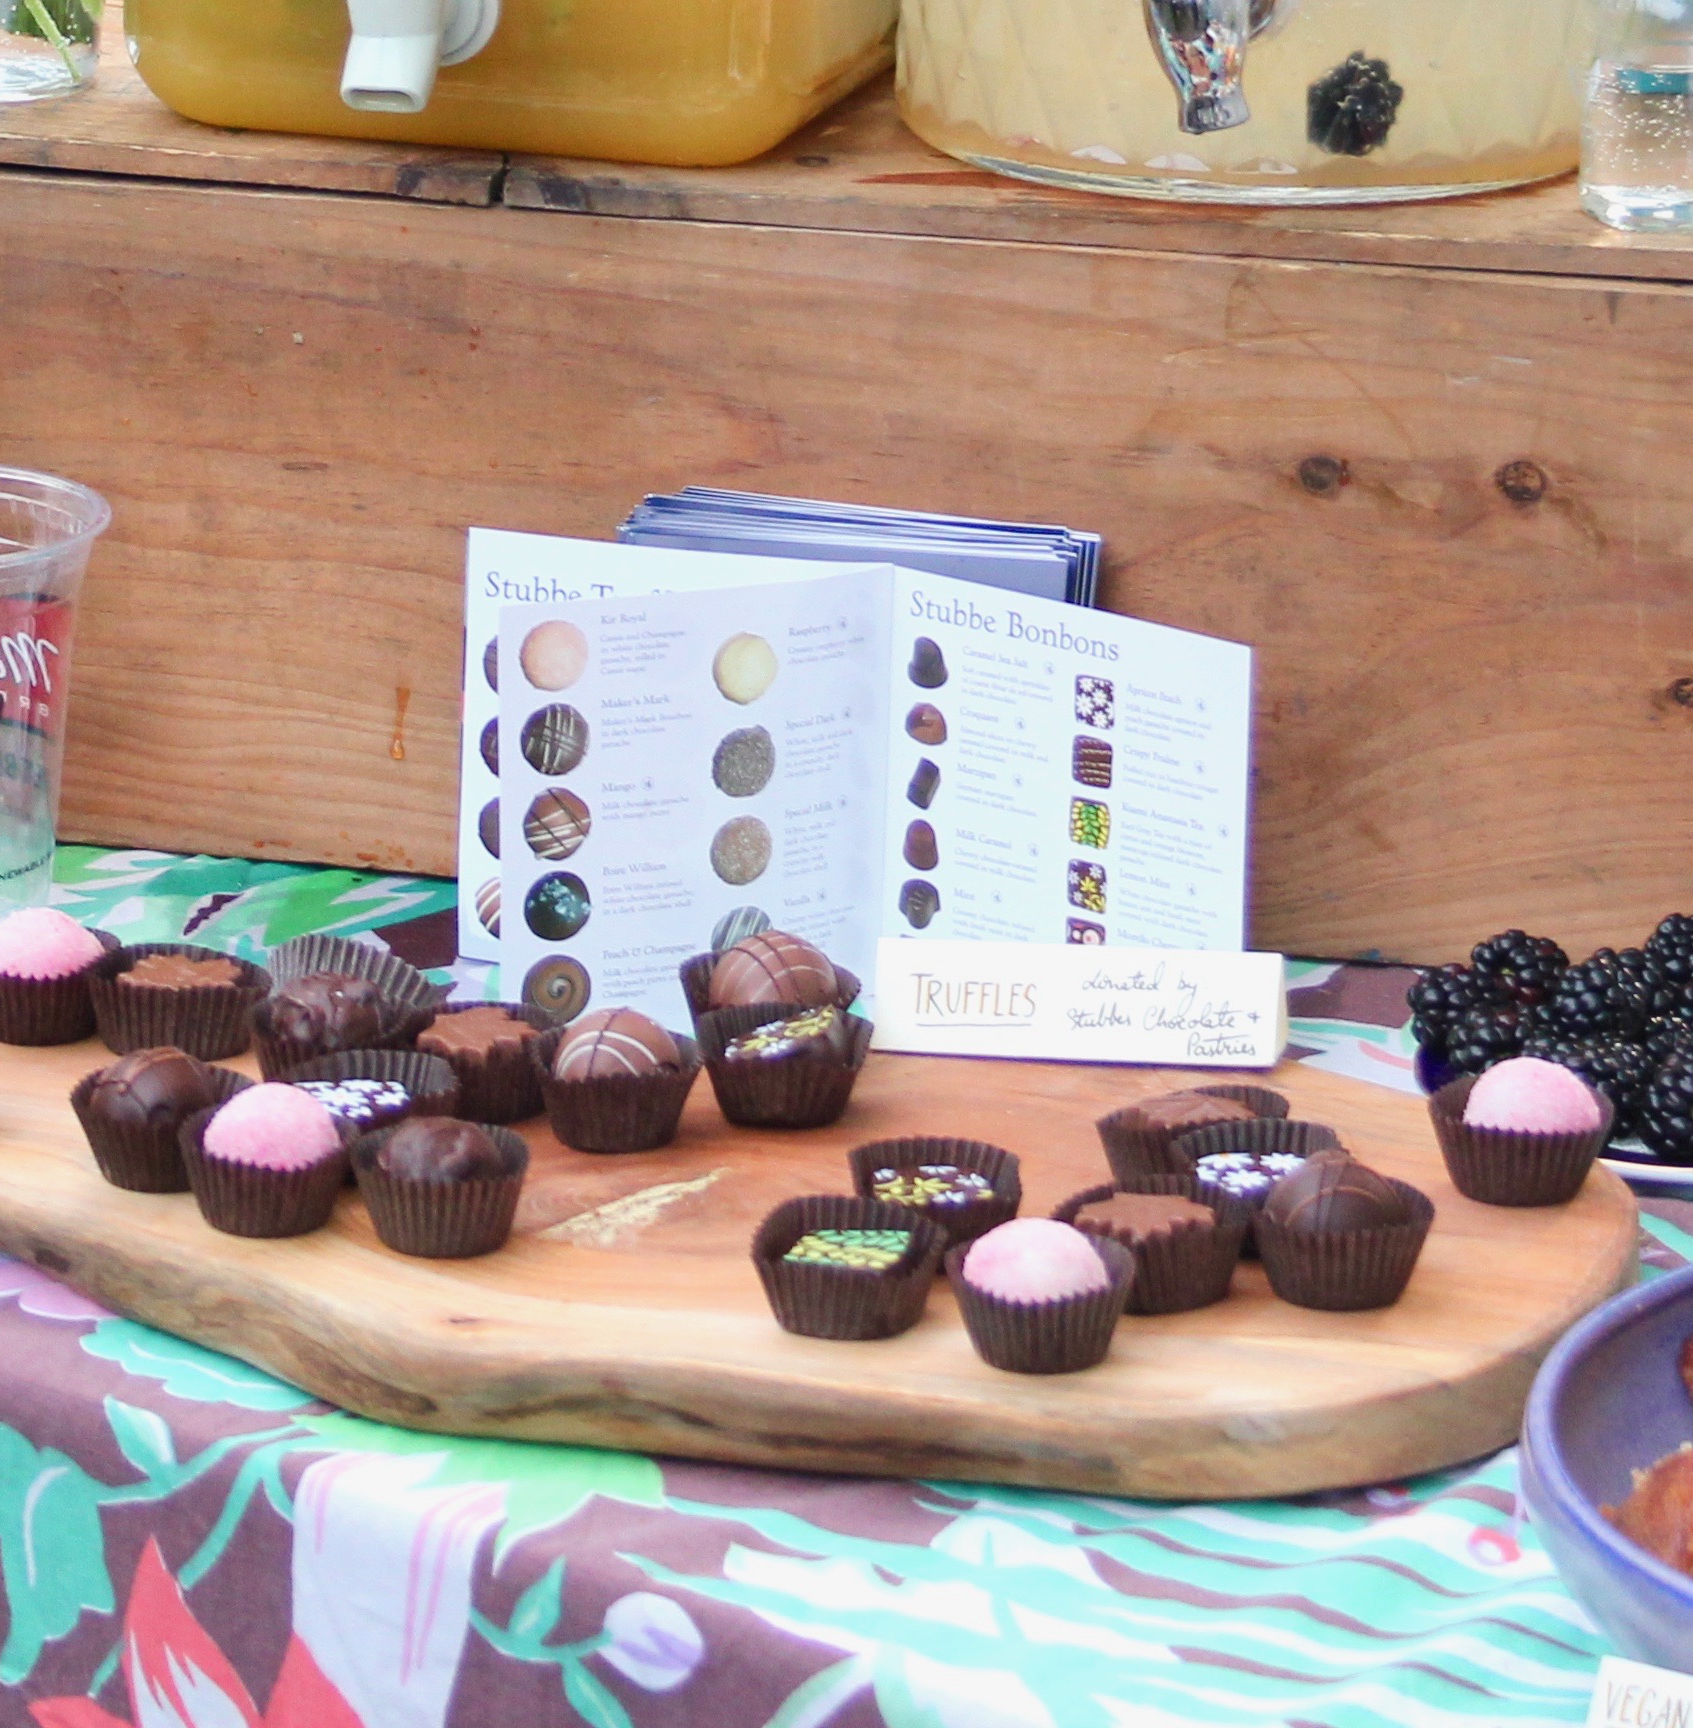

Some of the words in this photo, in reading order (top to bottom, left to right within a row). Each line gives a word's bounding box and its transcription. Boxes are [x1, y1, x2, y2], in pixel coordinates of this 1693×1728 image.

[909, 590, 998, 634] Stubbe
[1006, 610, 1121, 663] Bonbons
[643, 693, 670, 706] Mark
[910, 972, 1037, 1018] TRUFFLES
[1081, 960, 1167, 992] donated
[1186, 1031, 1257, 1058] Pastries
[1606, 1680, 1693, 1728] VEGAN
